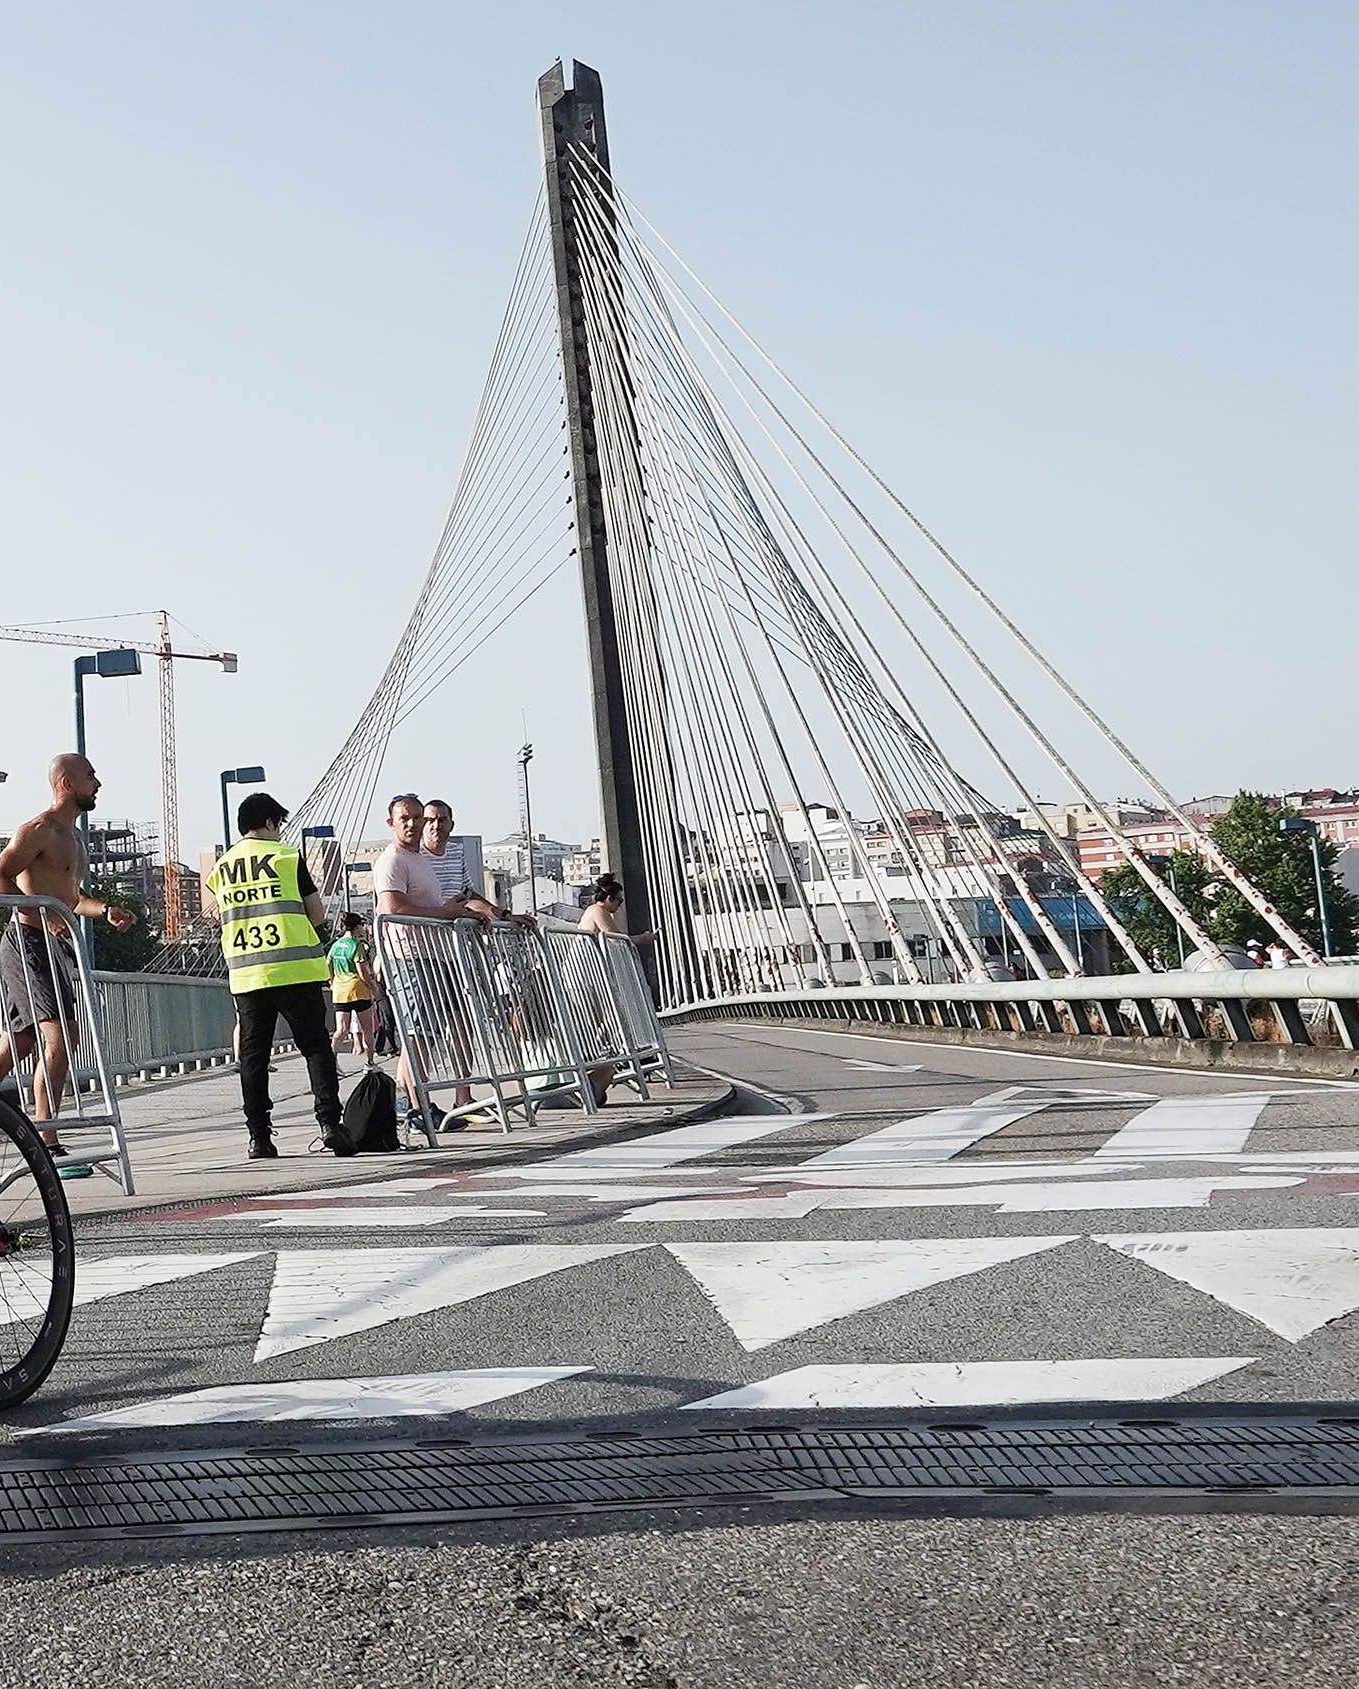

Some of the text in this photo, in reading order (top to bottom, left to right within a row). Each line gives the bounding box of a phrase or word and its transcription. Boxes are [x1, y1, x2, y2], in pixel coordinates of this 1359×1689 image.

[219, 853, 279, 886] MK
[223, 885, 282, 904] NORTE
[233, 924, 280, 950] 433
